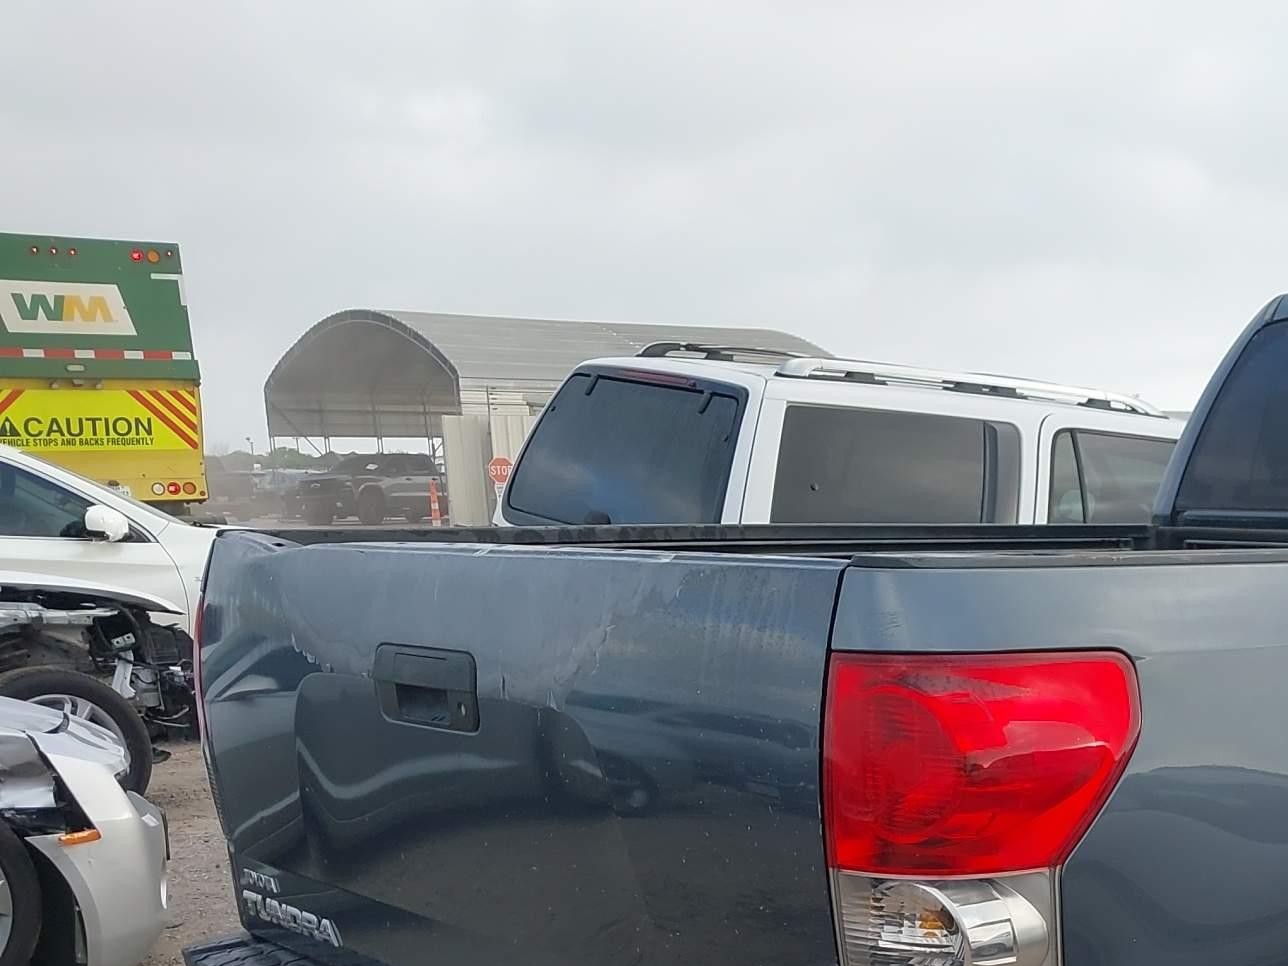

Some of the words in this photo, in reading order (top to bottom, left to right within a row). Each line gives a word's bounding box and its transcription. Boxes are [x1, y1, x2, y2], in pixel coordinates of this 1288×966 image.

[11, 293, 113, 322] WM
[23, 416, 153, 437] CAUTION
[33, 438, 58, 447] STOPS
[61, 438, 77, 446] AND
[79, 437, 104, 446] BACKS
[106, 437, 154, 446] FREQUENTLY
[242, 889, 343, 947] TUNDRA
